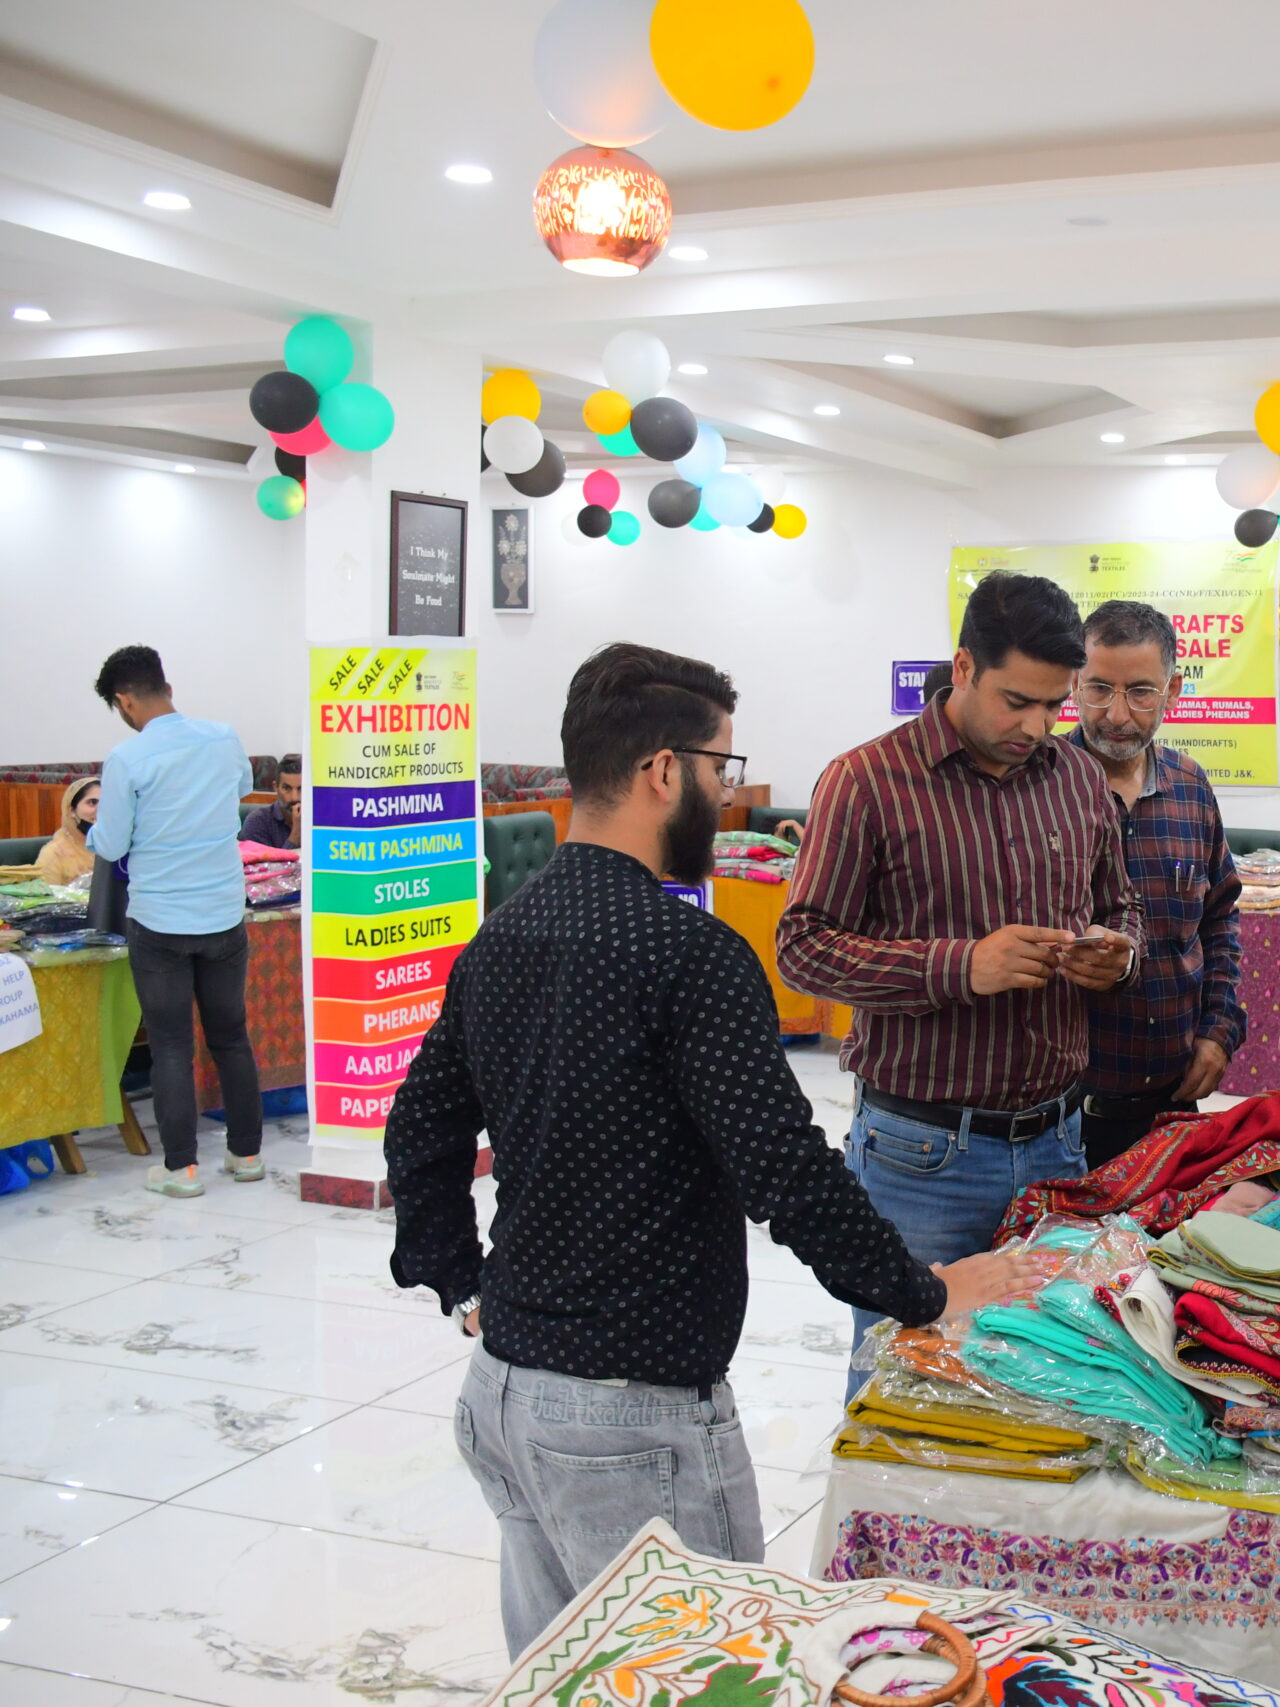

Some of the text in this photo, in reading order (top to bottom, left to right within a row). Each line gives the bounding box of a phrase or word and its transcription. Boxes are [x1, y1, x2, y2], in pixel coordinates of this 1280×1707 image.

[410, 546, 449, 561] I Think My
[402, 569, 455, 585] Soulmate Might
[415, 594, 442, 606] Be Food
[1176, 639, 1231, 658] SALE
[329, 655, 357, 691] SALE
[357, 659, 385, 695] SALE
[388, 659, 413, 695] SALE
[1171, 710, 1203, 719] LADIES
[1205, 710, 1250, 719] PHERANS
[1176, 701, 1210, 711] JAMAS,
[1212, 701, 1254, 711] RUMALS,
[320, 703, 470, 733] EXHIBITION
[362, 743, 436, 758] CUM SALE OF
[1172, 739, 1237, 749] (HANDICRAFTS)
[329, 761, 464, 779] HANDICRAFT PRODUCTS
[1206, 769, 1256, 779] MITED J&K.
[352, 793, 444, 818] PASHMINA
[329, 832, 463, 861] SEMI PASHMINA
[374, 878, 430, 904] STOLES
[345, 916, 452, 947] LADIES SUITS
[2, 970, 25, 986] HELP
[375, 961, 432, 989] SAREES
[0, 990, 23, 1006] ROUP
[364, 1000, 440, 1033] PHERANS
[345, 1054, 392, 1076] AARI
